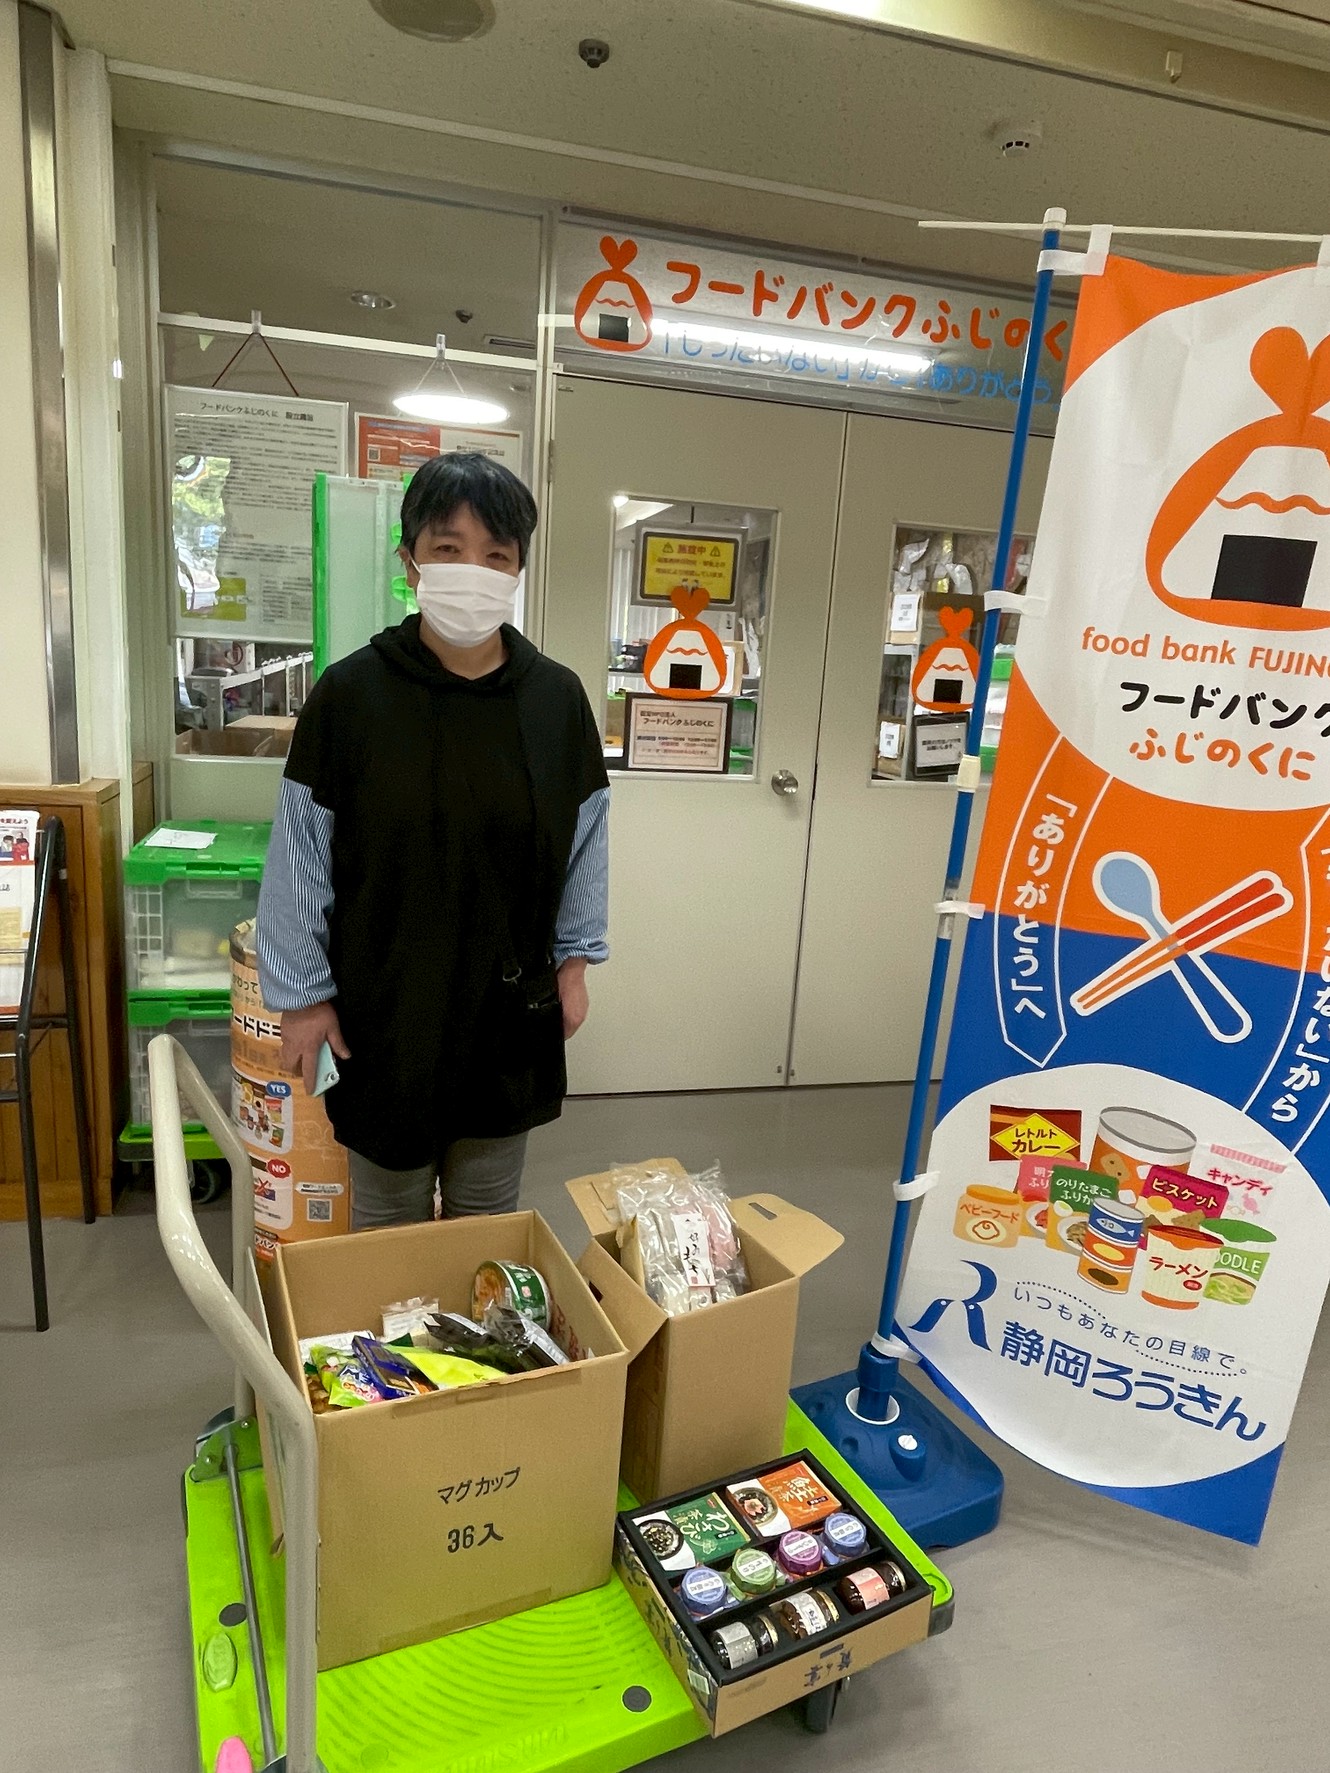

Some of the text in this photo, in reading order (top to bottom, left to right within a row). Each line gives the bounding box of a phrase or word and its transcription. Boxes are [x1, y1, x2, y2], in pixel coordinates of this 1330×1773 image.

[666, 261, 1069, 361] フードバンクふじのく
[1081, 626, 1330, 678] food bank FUJIN
[1129, 727, 1316, 781] ふじのくに
[1010, 793, 1078, 1019] 「ありがとう」へ
[270, 1084, 287, 1095] YES
[1012, 1138, 1061, 1153] カレー
[1014, 1127, 1058, 1140] レトルト
[271, 1164, 286, 1174] NO
[1207, 1167, 1274, 1196] キャンディ
[1151, 1177, 1219, 1210] ビスケット
[1149, 1255, 1208, 1280] ラーメン
[1216, 1252, 1262, 1275] ODLE
[1014, 1284, 1248, 1375] いつもあなたの目線で。
[1000, 1320, 1266, 1442] 静岡ろうきん
[436, 1466, 521, 1505] マグカップ
[447, 1522, 504, 1553] 36入
[679, 1511, 730, 1541] わさび
